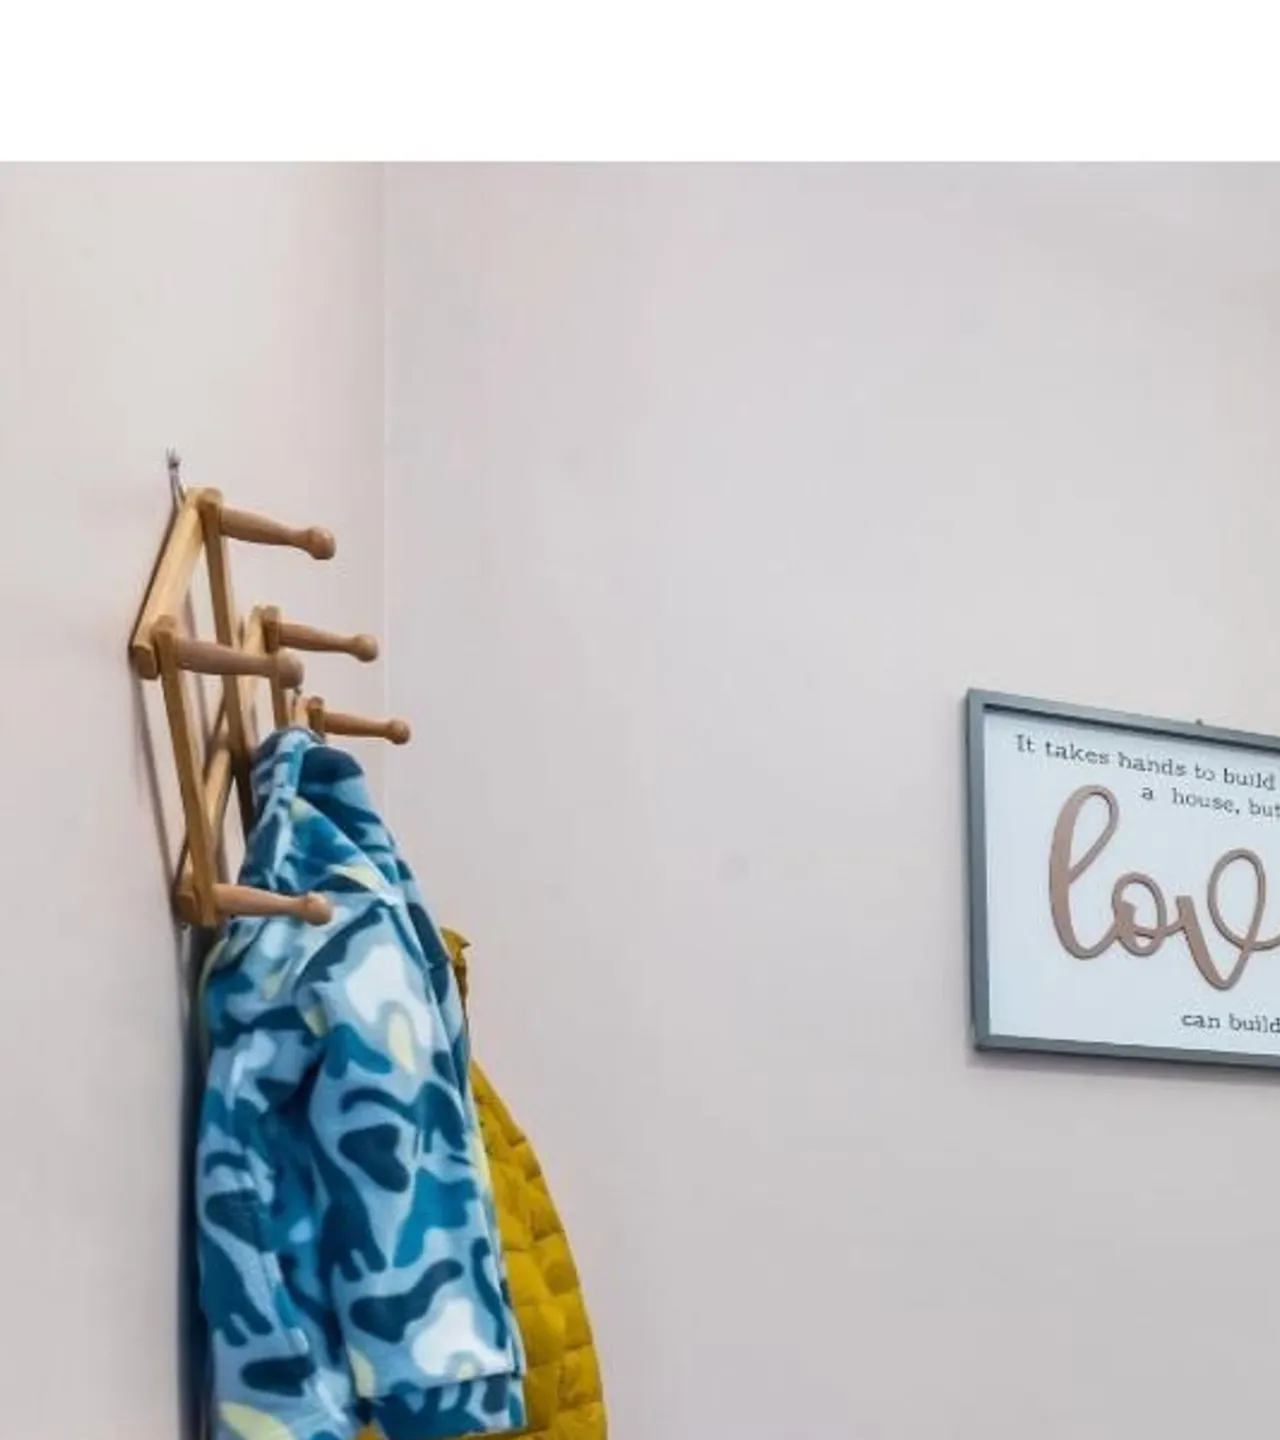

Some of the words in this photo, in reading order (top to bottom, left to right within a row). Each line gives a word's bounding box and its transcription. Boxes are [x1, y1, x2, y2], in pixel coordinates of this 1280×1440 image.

[1016, 734, 1035, 753] It
[1045, 742, 1110, 765] takes
[1117, 751, 1186, 776] hands
[1194, 762, 1215, 782] to
[1223, 767, 1276, 791] build
[1142, 786, 1155, 800] a
[1172, 787, 1241, 815] house,
[1181, 1013, 1220, 1030] can
